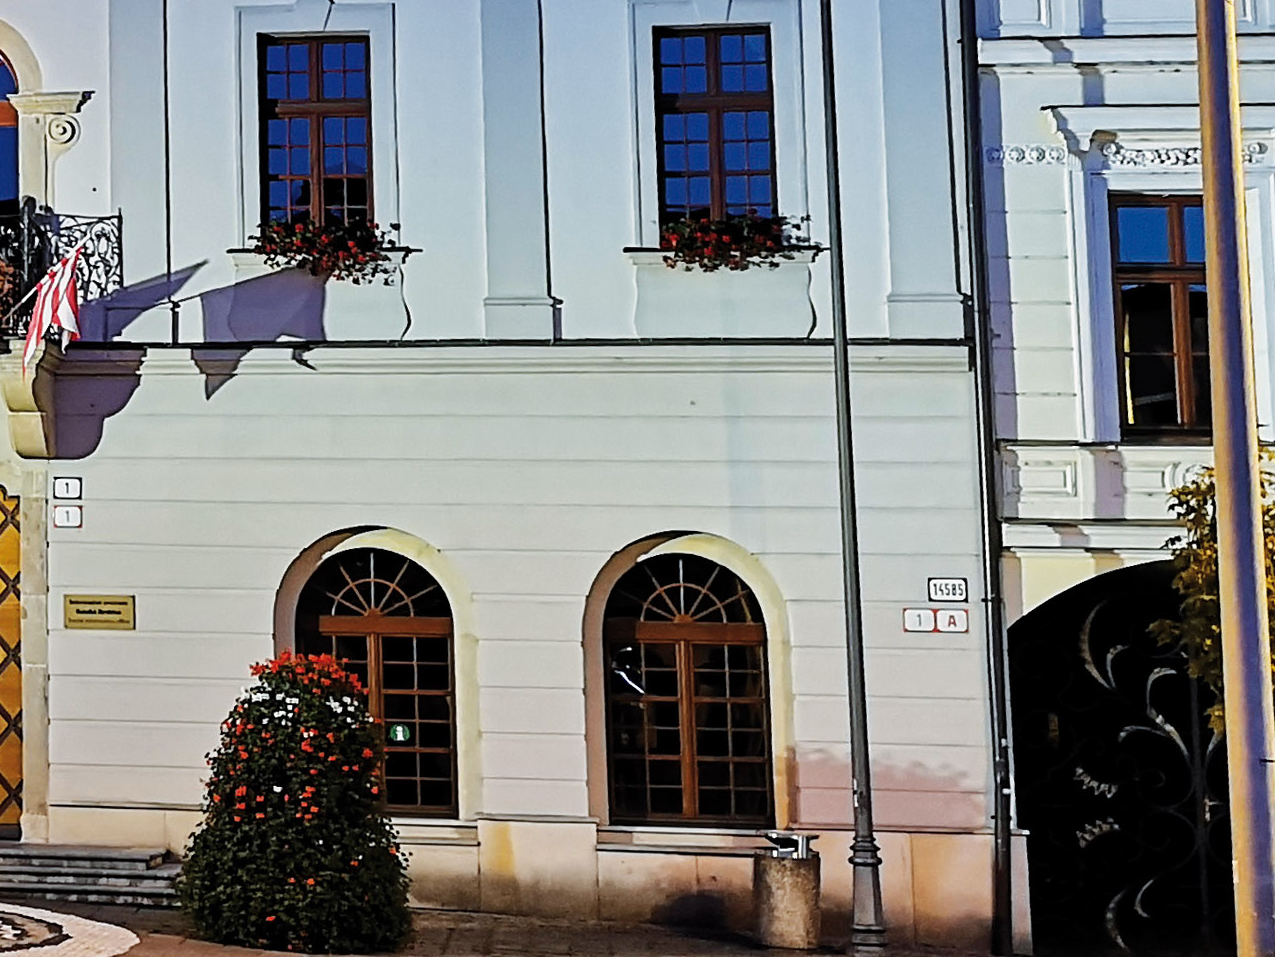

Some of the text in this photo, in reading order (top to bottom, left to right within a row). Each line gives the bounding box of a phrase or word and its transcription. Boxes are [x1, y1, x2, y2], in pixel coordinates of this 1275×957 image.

[65, 482, 69, 494] 1
[65, 510, 70, 523] 1
[933, 583, 964, 596] 14585
[917, 614, 957, 627] 1 A
